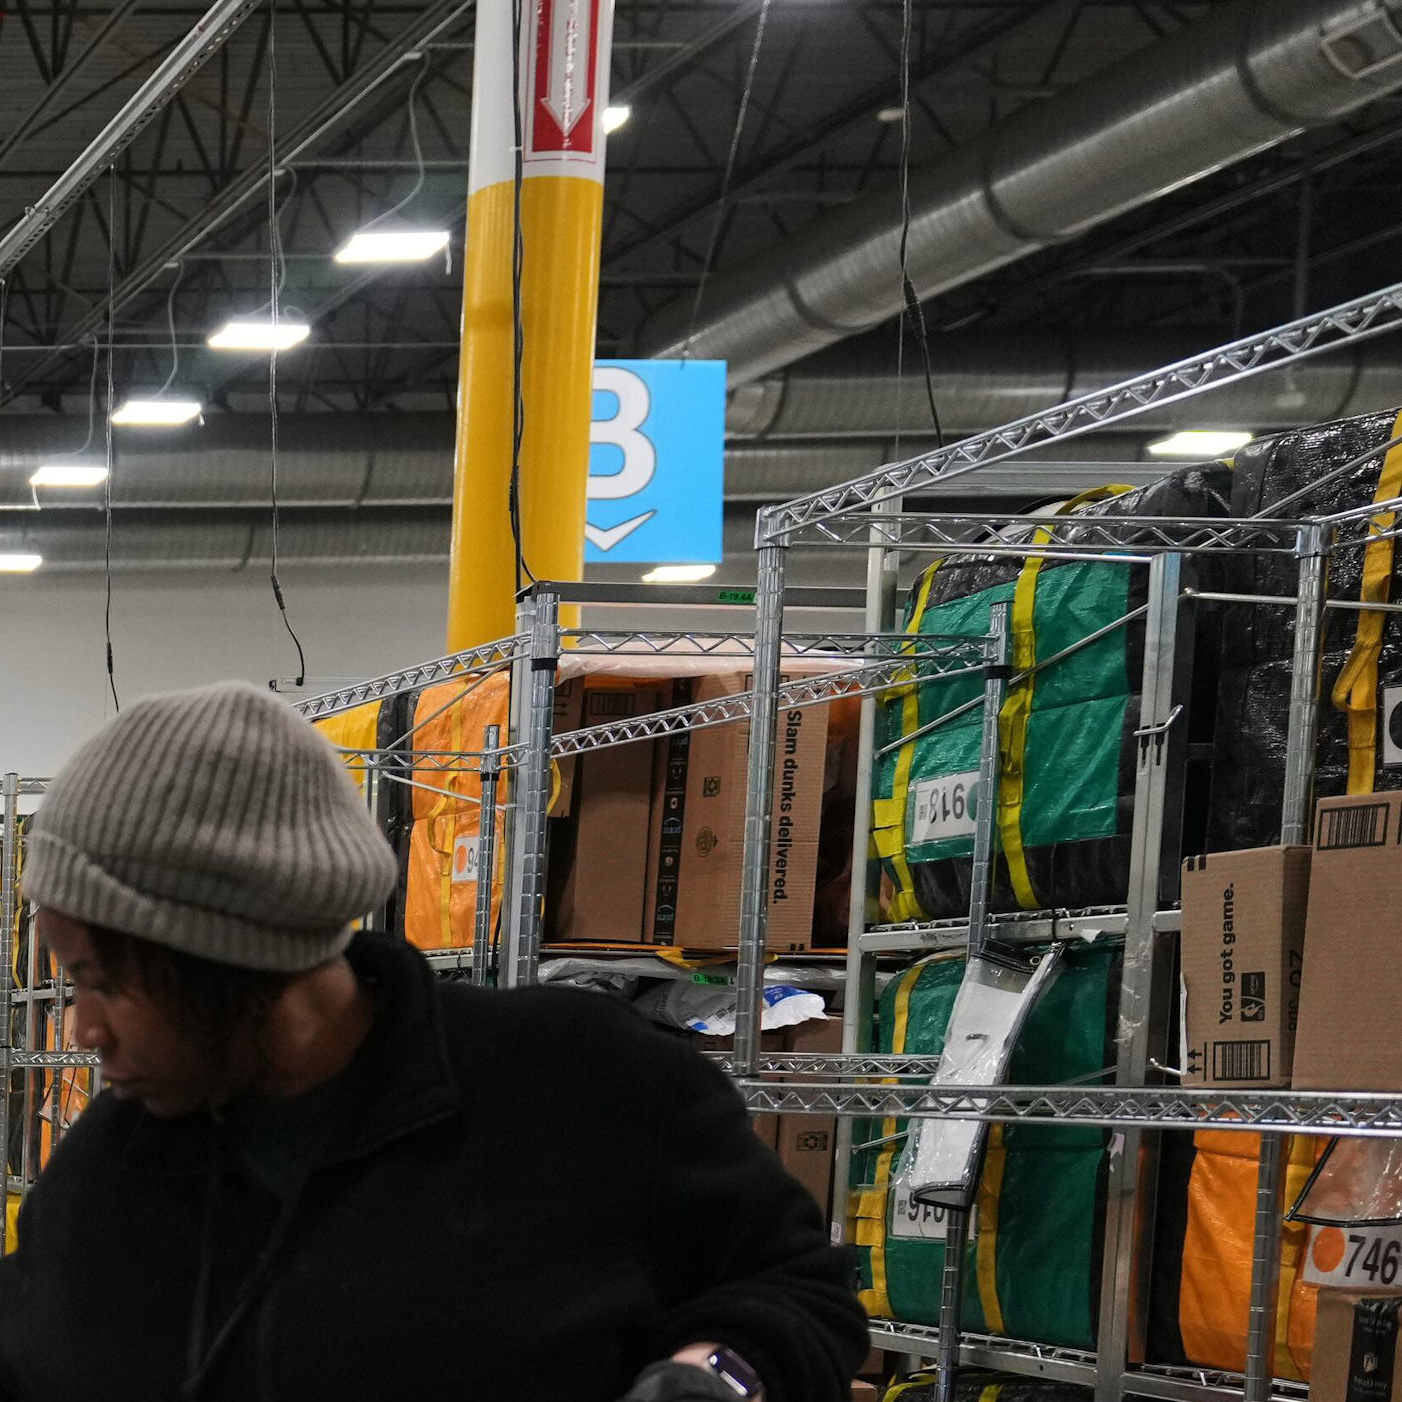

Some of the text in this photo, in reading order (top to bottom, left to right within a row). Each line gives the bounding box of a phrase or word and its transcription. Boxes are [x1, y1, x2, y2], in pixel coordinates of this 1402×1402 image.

[587, 366, 657, 499] B
[772, 711, 802, 904] Slam dunks delivered.
[1220, 882, 1235, 1025] You got game.
[1345, 1234, 1401, 1285] 746
